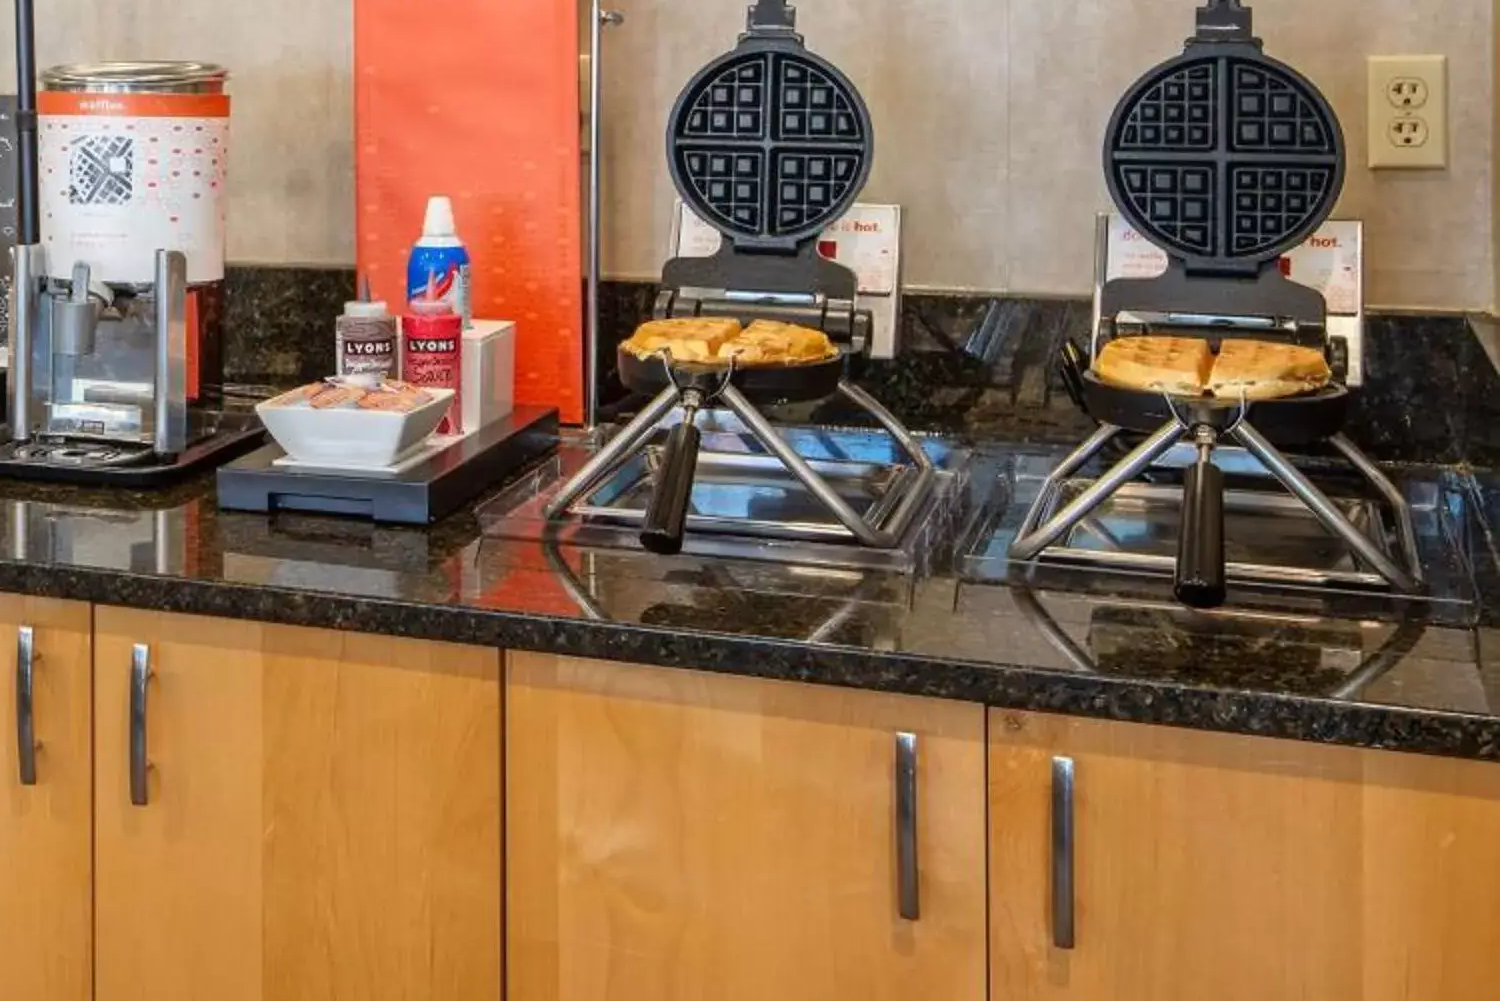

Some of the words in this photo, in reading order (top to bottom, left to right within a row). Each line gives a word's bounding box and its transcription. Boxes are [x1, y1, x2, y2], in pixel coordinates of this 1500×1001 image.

[853, 220, 882, 233] hot.
[1309, 235, 1343, 248] hot.
[346, 341, 391, 354] LYONS
[412, 339, 455, 352] LYONS
